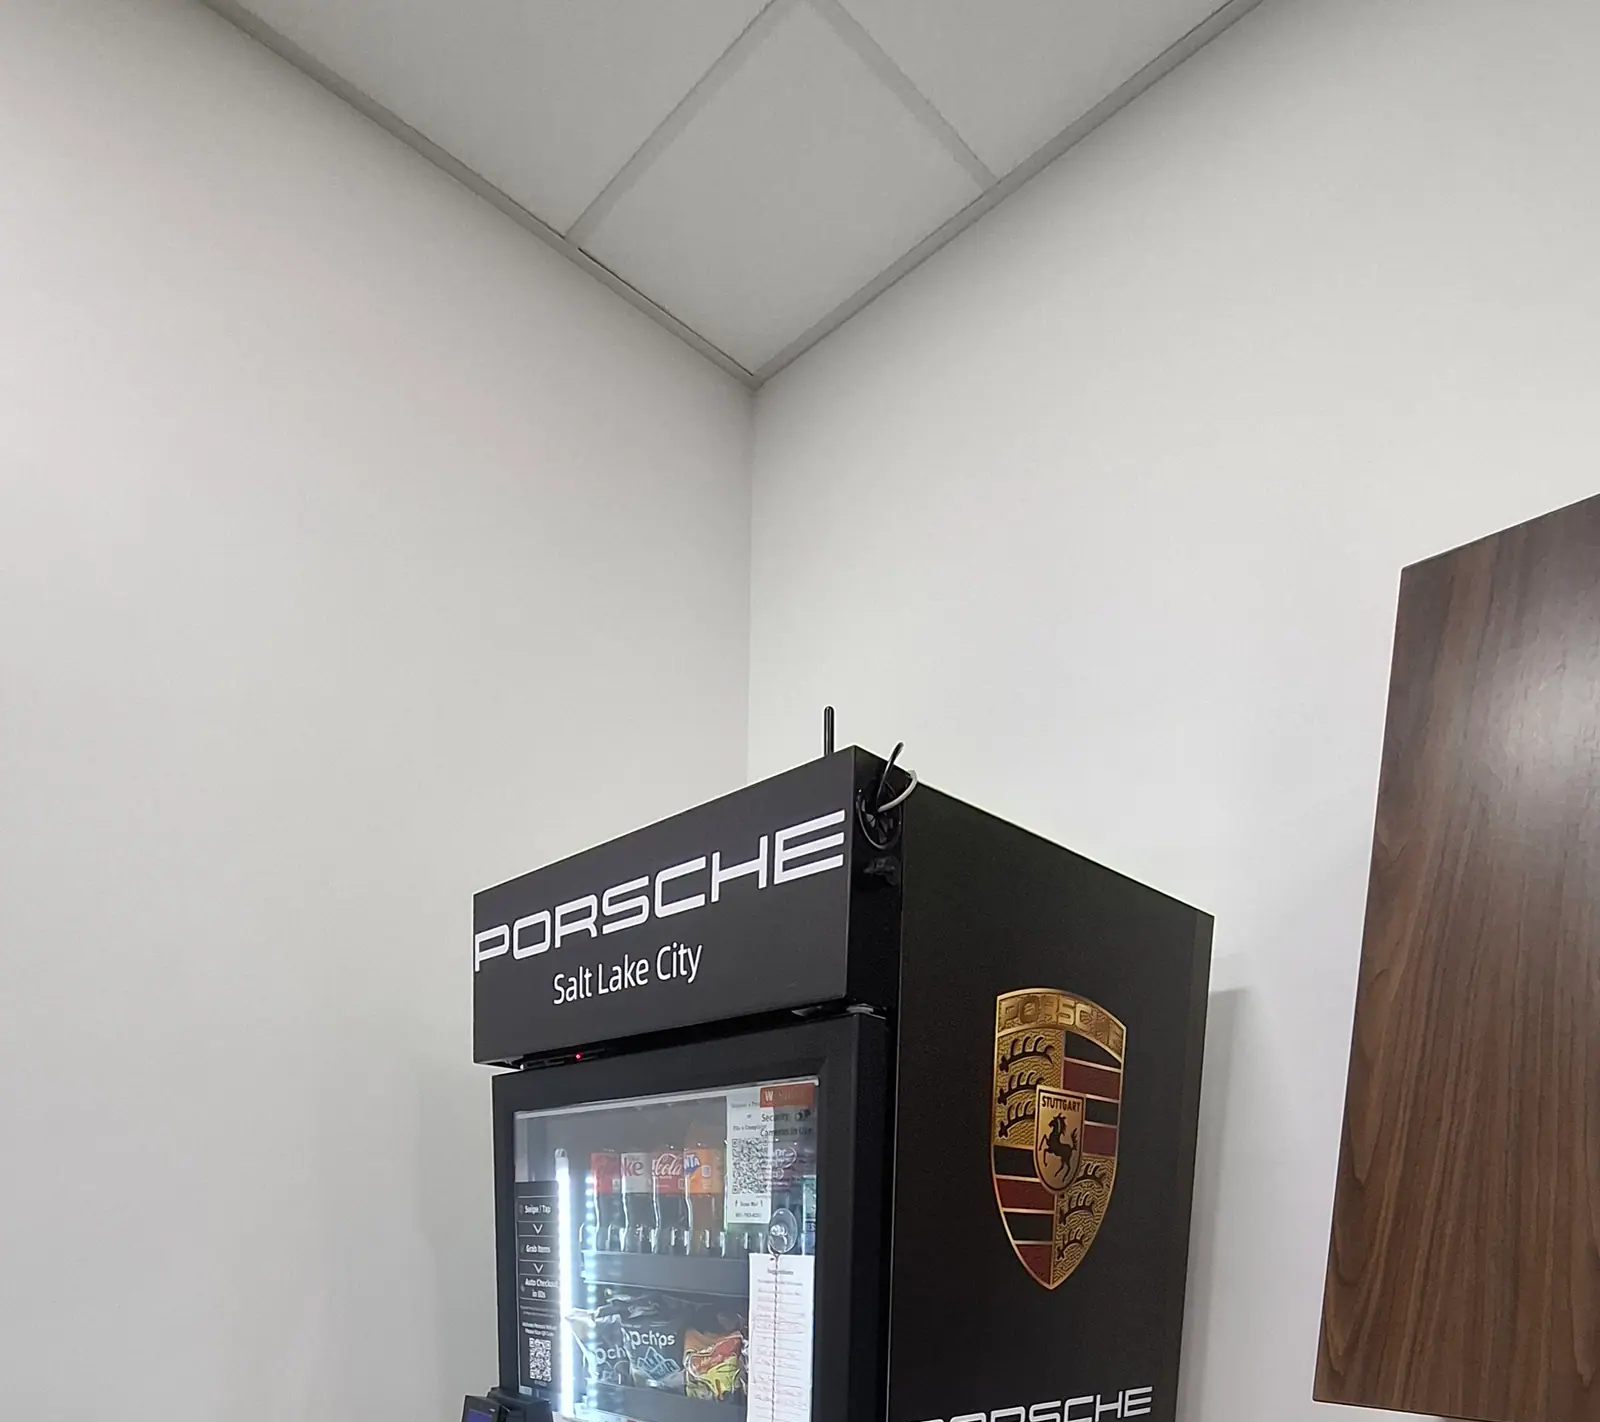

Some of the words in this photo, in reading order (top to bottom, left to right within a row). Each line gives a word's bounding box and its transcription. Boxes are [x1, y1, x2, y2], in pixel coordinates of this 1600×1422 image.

[474, 810, 846, 972] PORSCHE
[553, 966, 593, 1005] Salt
[598, 954, 649, 994] Lake
[656, 942, 703, 984] City
[1000, 994, 1123, 1057] PORSCHE
[1041, 1095, 1081, 1113] STUTTGART
